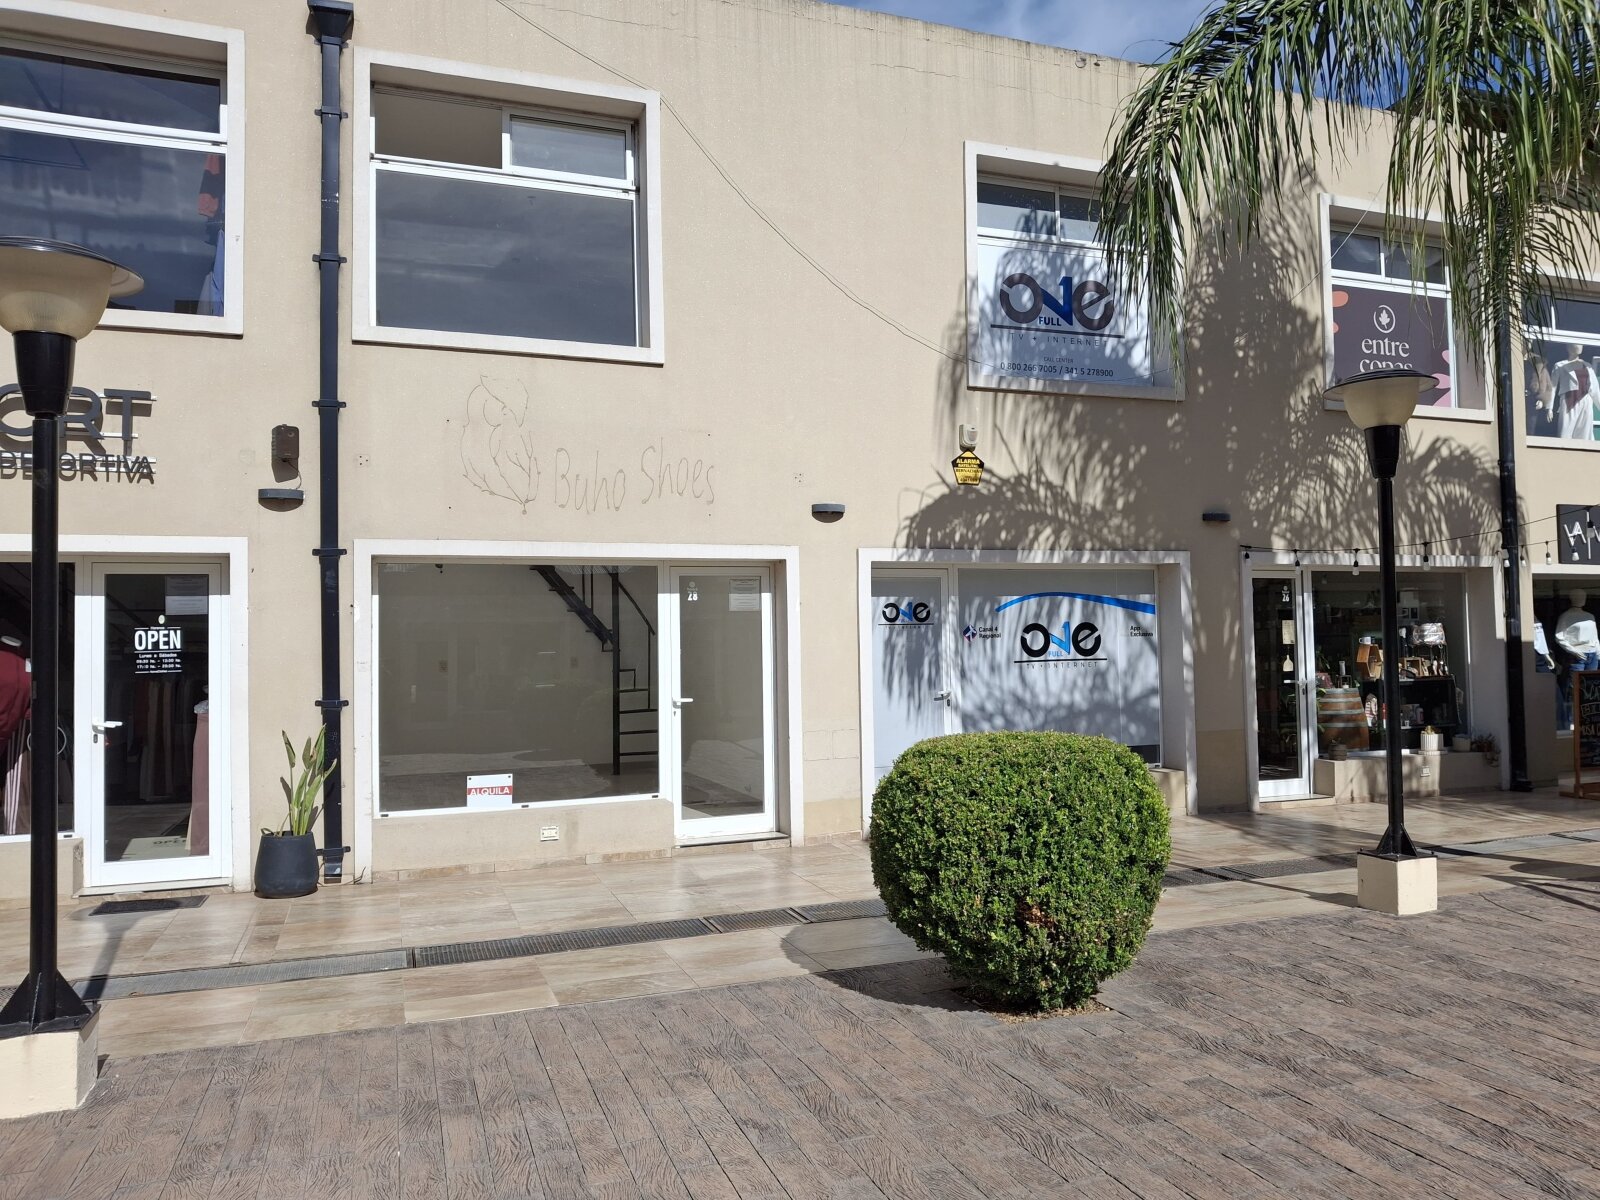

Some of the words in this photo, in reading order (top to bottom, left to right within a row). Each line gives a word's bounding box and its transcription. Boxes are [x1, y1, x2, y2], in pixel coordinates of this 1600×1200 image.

[1039, 316, 1062, 327] FULL
[1010, 333, 1024, 341] TV
[1361, 337, 1410, 358] entre
[1007, 362, 1021, 371] 800
[1023, 363, 1037, 372] 266
[1039, 364, 1057, 373] 7005
[1065, 366, 1078, 375] 341
[1080, 367, 1085, 375] 5
[1087, 368, 1114, 377] 278900
[0, 450, 155, 475] DEORTIVA
[641, 436, 714, 505] Shoes
[687, 591, 698, 601] 28
[1282, 593, 1290, 602] 26
[134, 630, 181, 651] OPEN
[469, 786, 510, 796] ALQUILA
